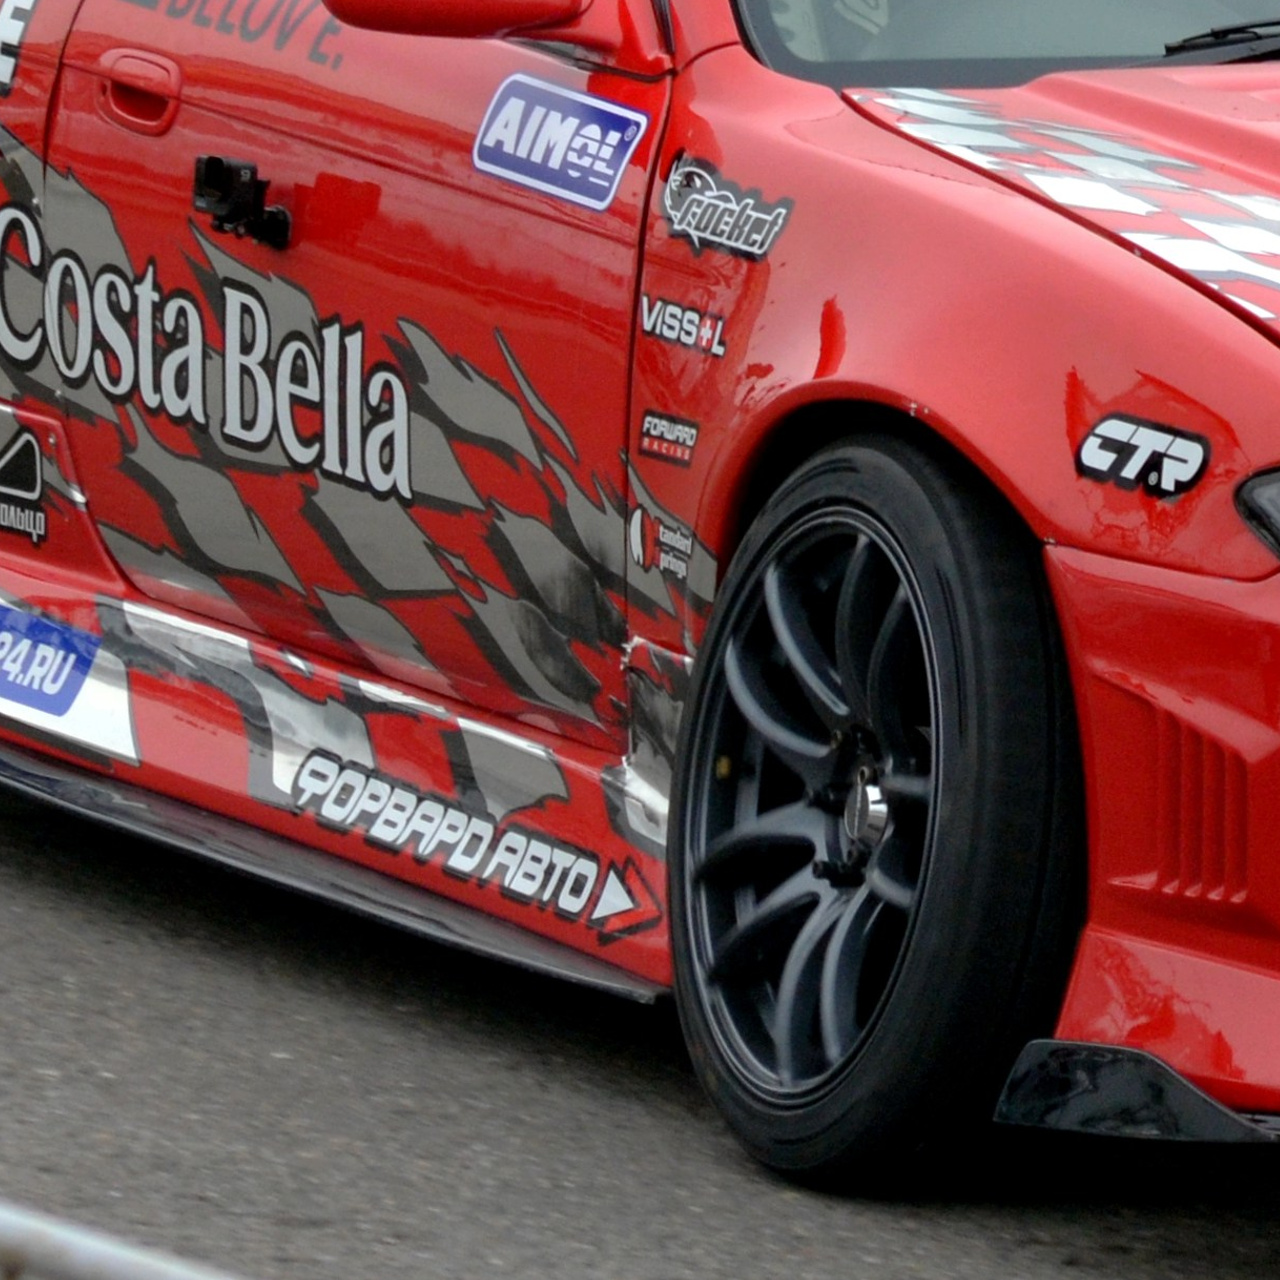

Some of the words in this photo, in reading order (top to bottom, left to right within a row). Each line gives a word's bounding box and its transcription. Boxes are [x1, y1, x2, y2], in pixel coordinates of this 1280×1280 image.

[482, 96, 622, 187] AIMOL
[0, 206, 207, 425] Costa
[222, 286, 412, 500] Bella
[642, 415, 698, 448] FORWARD
[1081, 419, 1204, 492] CTR
[482, 830, 600, 914] АВТО
